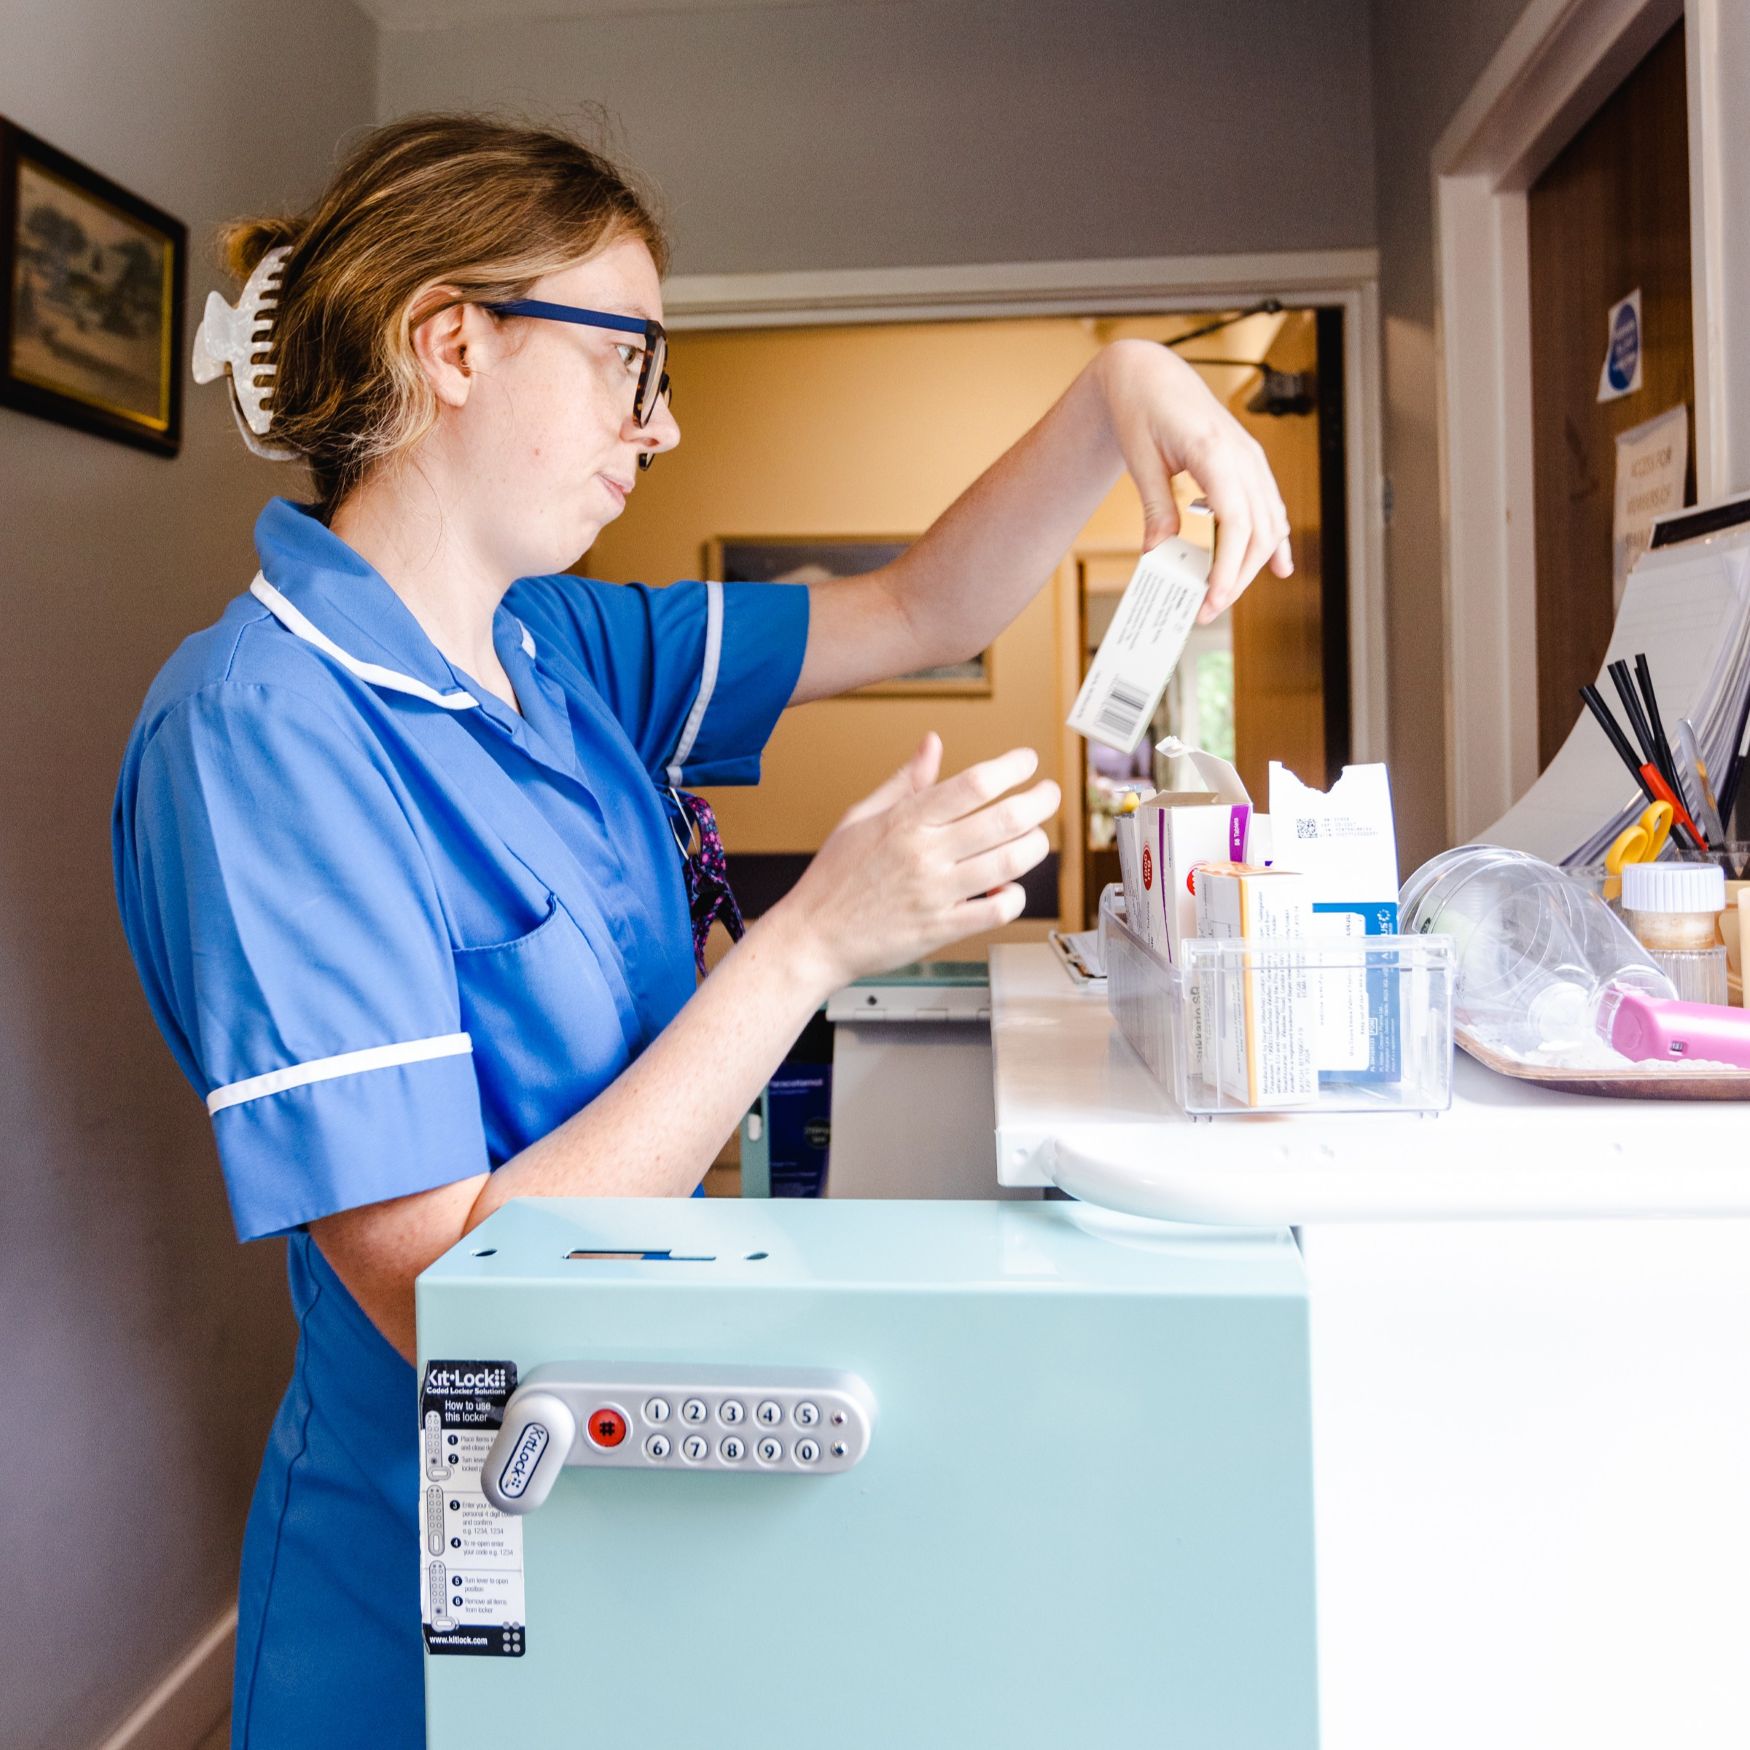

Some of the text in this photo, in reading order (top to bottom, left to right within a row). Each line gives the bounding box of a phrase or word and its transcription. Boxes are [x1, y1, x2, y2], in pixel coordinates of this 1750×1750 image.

[426, 1387, 449, 1395] Coded
[450, 1387, 474, 1395] Locker
[445, 1400, 491, 1411] How to use
[445, 1412, 488, 1422] this locker
[655, 1405, 812, 1424] 1 2 3 4 5
[653, 1440, 663, 1456] 6
[690, 1441, 701, 1457] 7
[727, 1442, 738, 1458] 8
[764, 1444, 775, 1459] 9
[429, 1635, 488, 1646] www.kitlock.com
